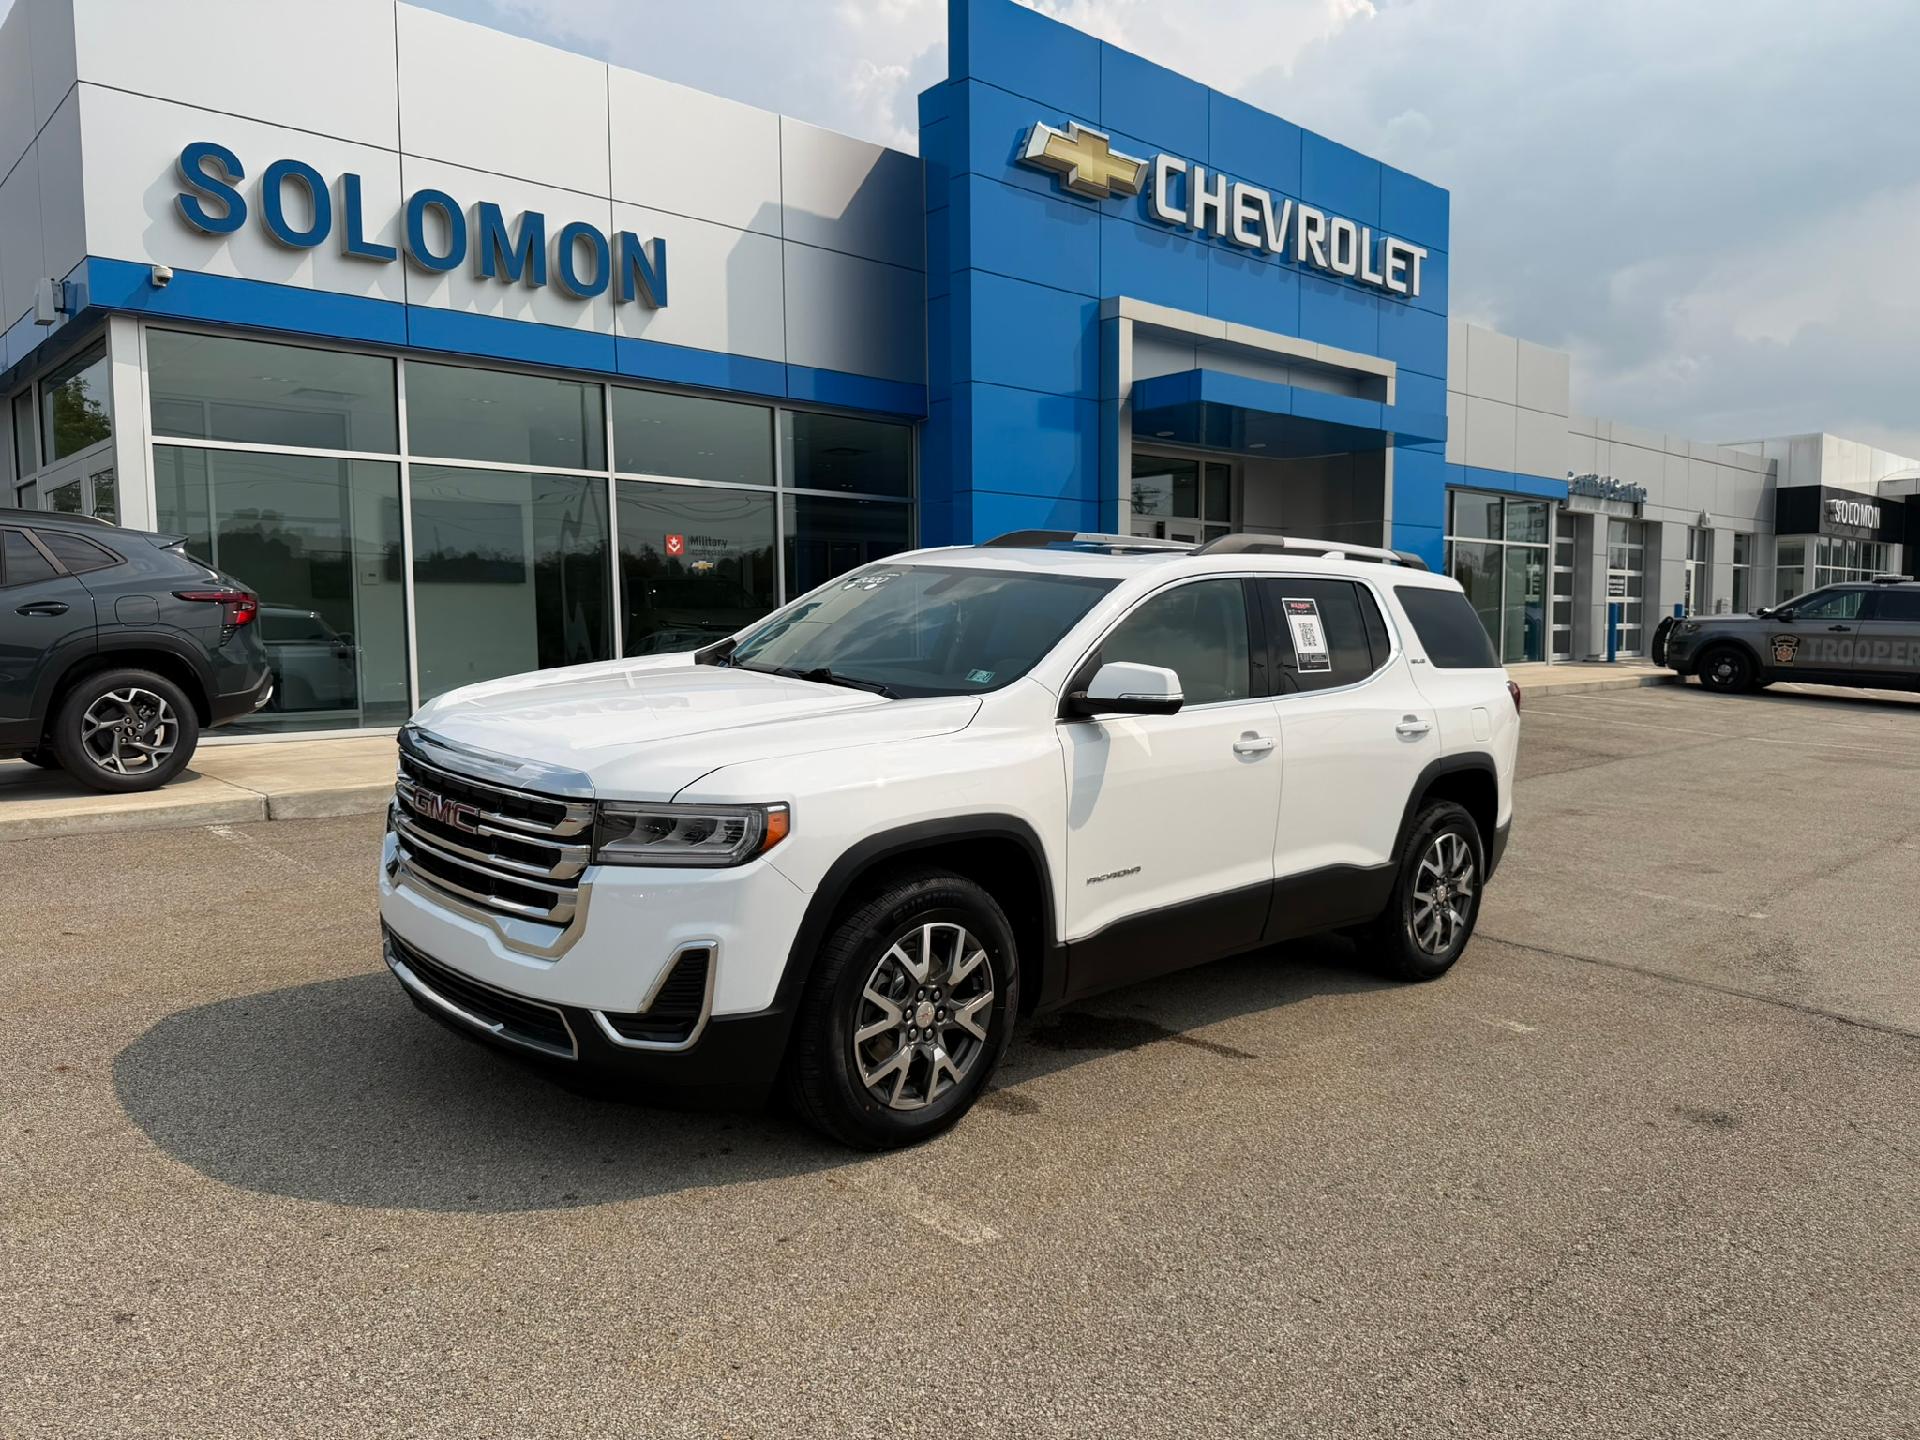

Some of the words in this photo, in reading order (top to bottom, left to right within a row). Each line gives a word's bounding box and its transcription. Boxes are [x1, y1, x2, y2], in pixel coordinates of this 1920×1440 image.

[174, 141, 669, 309] SOLOMON
[1149, 152, 1428, 298] CHEVROLET
[1830, 499, 1880, 529] SOLOMON
[688, 535, 728, 548] Military
[1807, 638, 1920, 667] TROOPER
[414, 786, 480, 835] GMC
